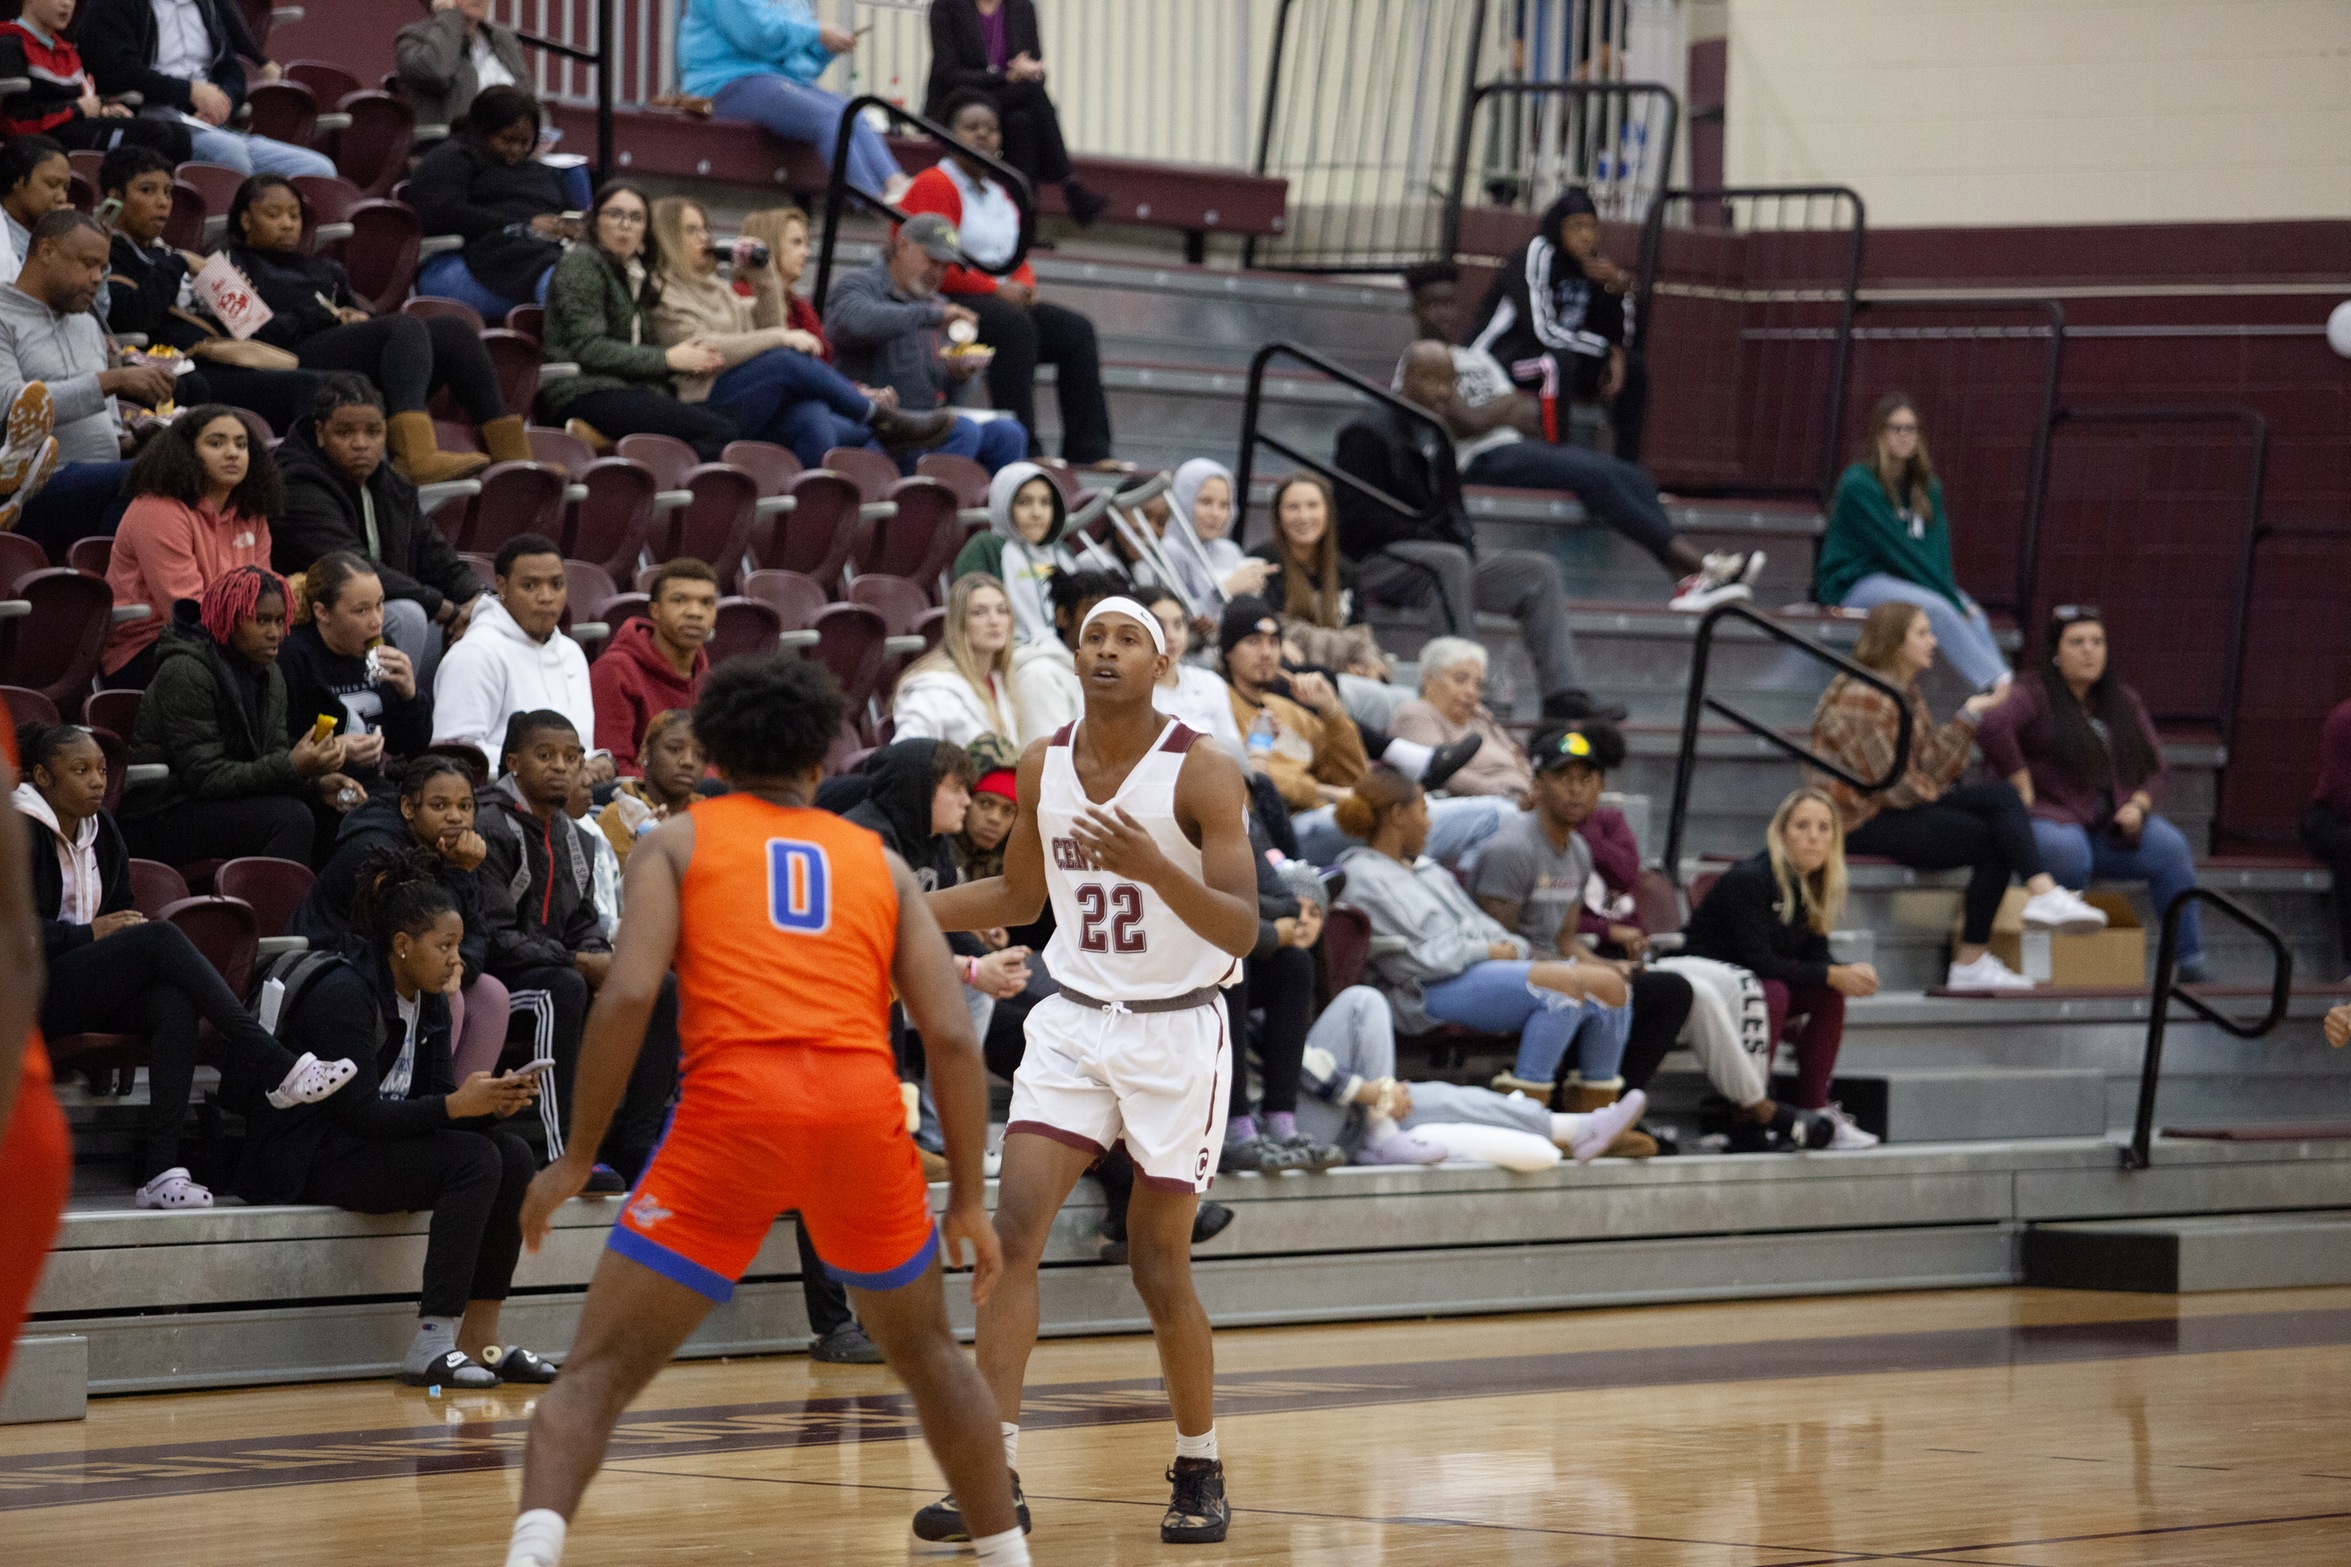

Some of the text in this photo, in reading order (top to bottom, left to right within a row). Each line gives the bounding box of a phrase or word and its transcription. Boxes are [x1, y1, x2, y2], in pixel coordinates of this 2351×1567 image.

[765, 837, 832, 935] 0
[1052, 837, 1110, 871] CEN
[1075, 883, 1147, 953] 22
